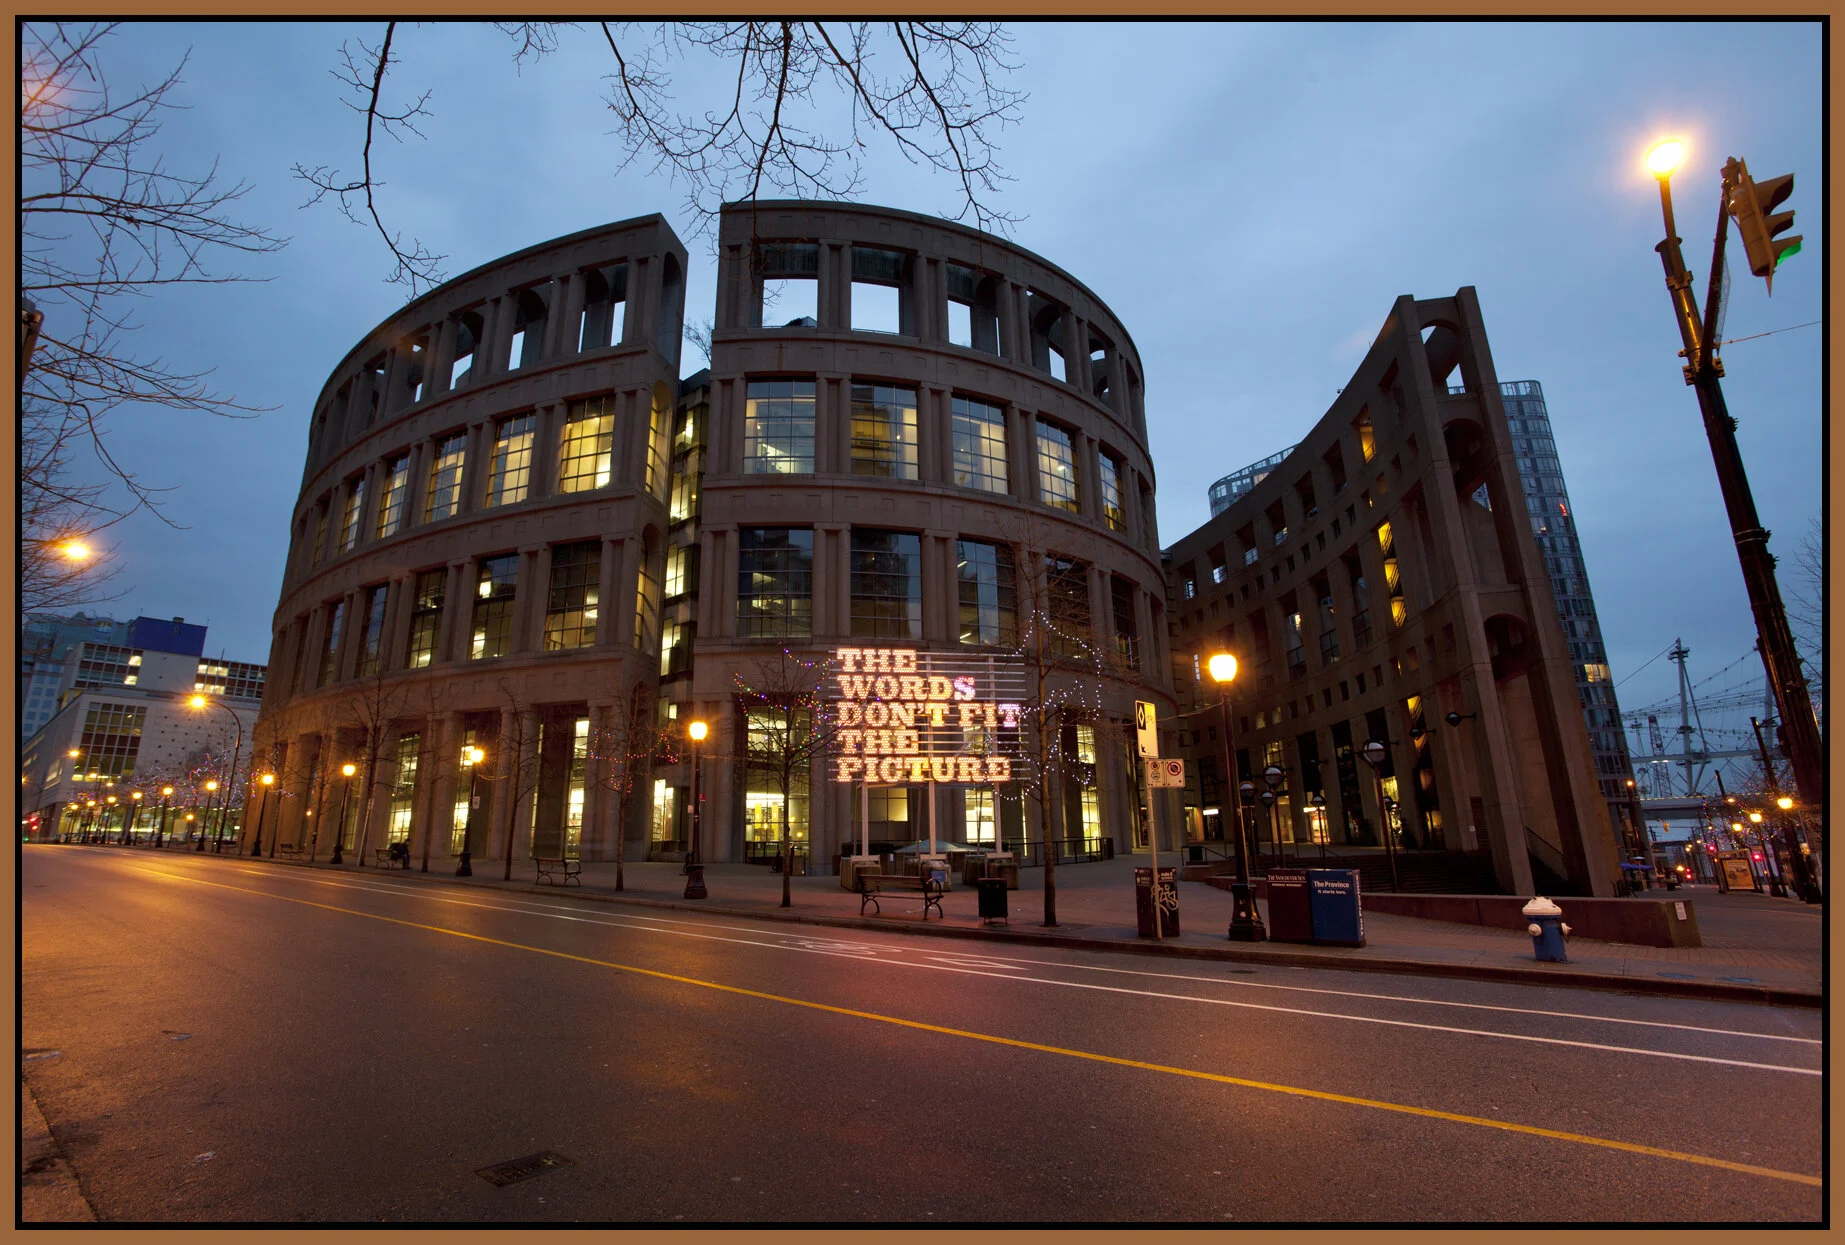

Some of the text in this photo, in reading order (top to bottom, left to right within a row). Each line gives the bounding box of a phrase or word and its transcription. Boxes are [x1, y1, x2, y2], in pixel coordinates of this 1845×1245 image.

[837, 648, 917, 673] THE
[837, 675, 976, 701] WORDS
[837, 701, 1021, 728] DON'T FIT
[837, 729, 919, 754] THE
[837, 756, 1011, 783] PICTURE
